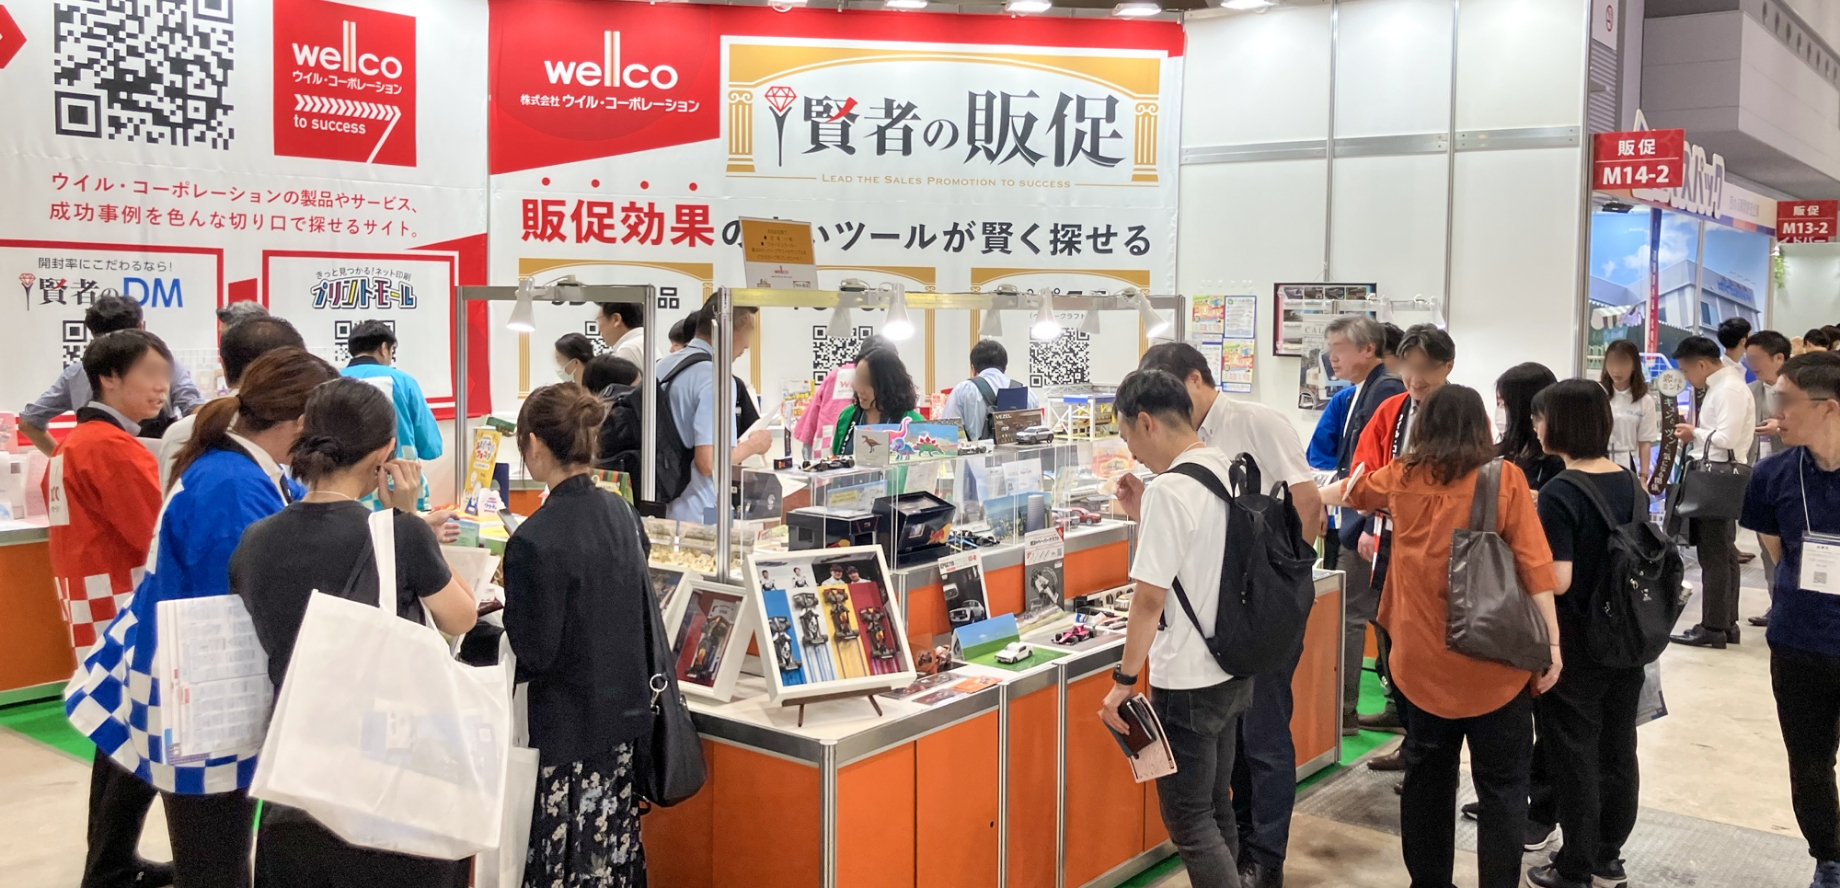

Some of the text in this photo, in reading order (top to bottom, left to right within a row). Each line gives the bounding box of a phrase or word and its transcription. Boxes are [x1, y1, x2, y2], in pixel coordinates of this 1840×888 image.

[292, 20, 403, 79] wellco
[544, 30, 678, 90] wellco
[292, 70, 402, 95] ウイル・コーポレーション
[520, 93, 700, 113] 株式会社 ウイル・コーポレーション
[294, 114, 366, 135] to success
[801, 90, 1126, 168] 賢者の販促
[1618, 139, 1656, 156] 販促
[1602, 165, 1669, 185] M14-2
[52, 173, 418, 214] ウイル・コーポレーションの製品やサービス、
[49, 204, 418, 238] 成功事例を色んな切り口で探せるサイト。
[1793, 205, 1819, 216] 販促
[1782, 222, 1828, 234] M13-2
[38, 257, 172, 272] 開封率にこだわるなら!
[315, 267, 412, 281] きっと見つかる!ネット印刷
[311, 276, 417, 309] プリントモール
